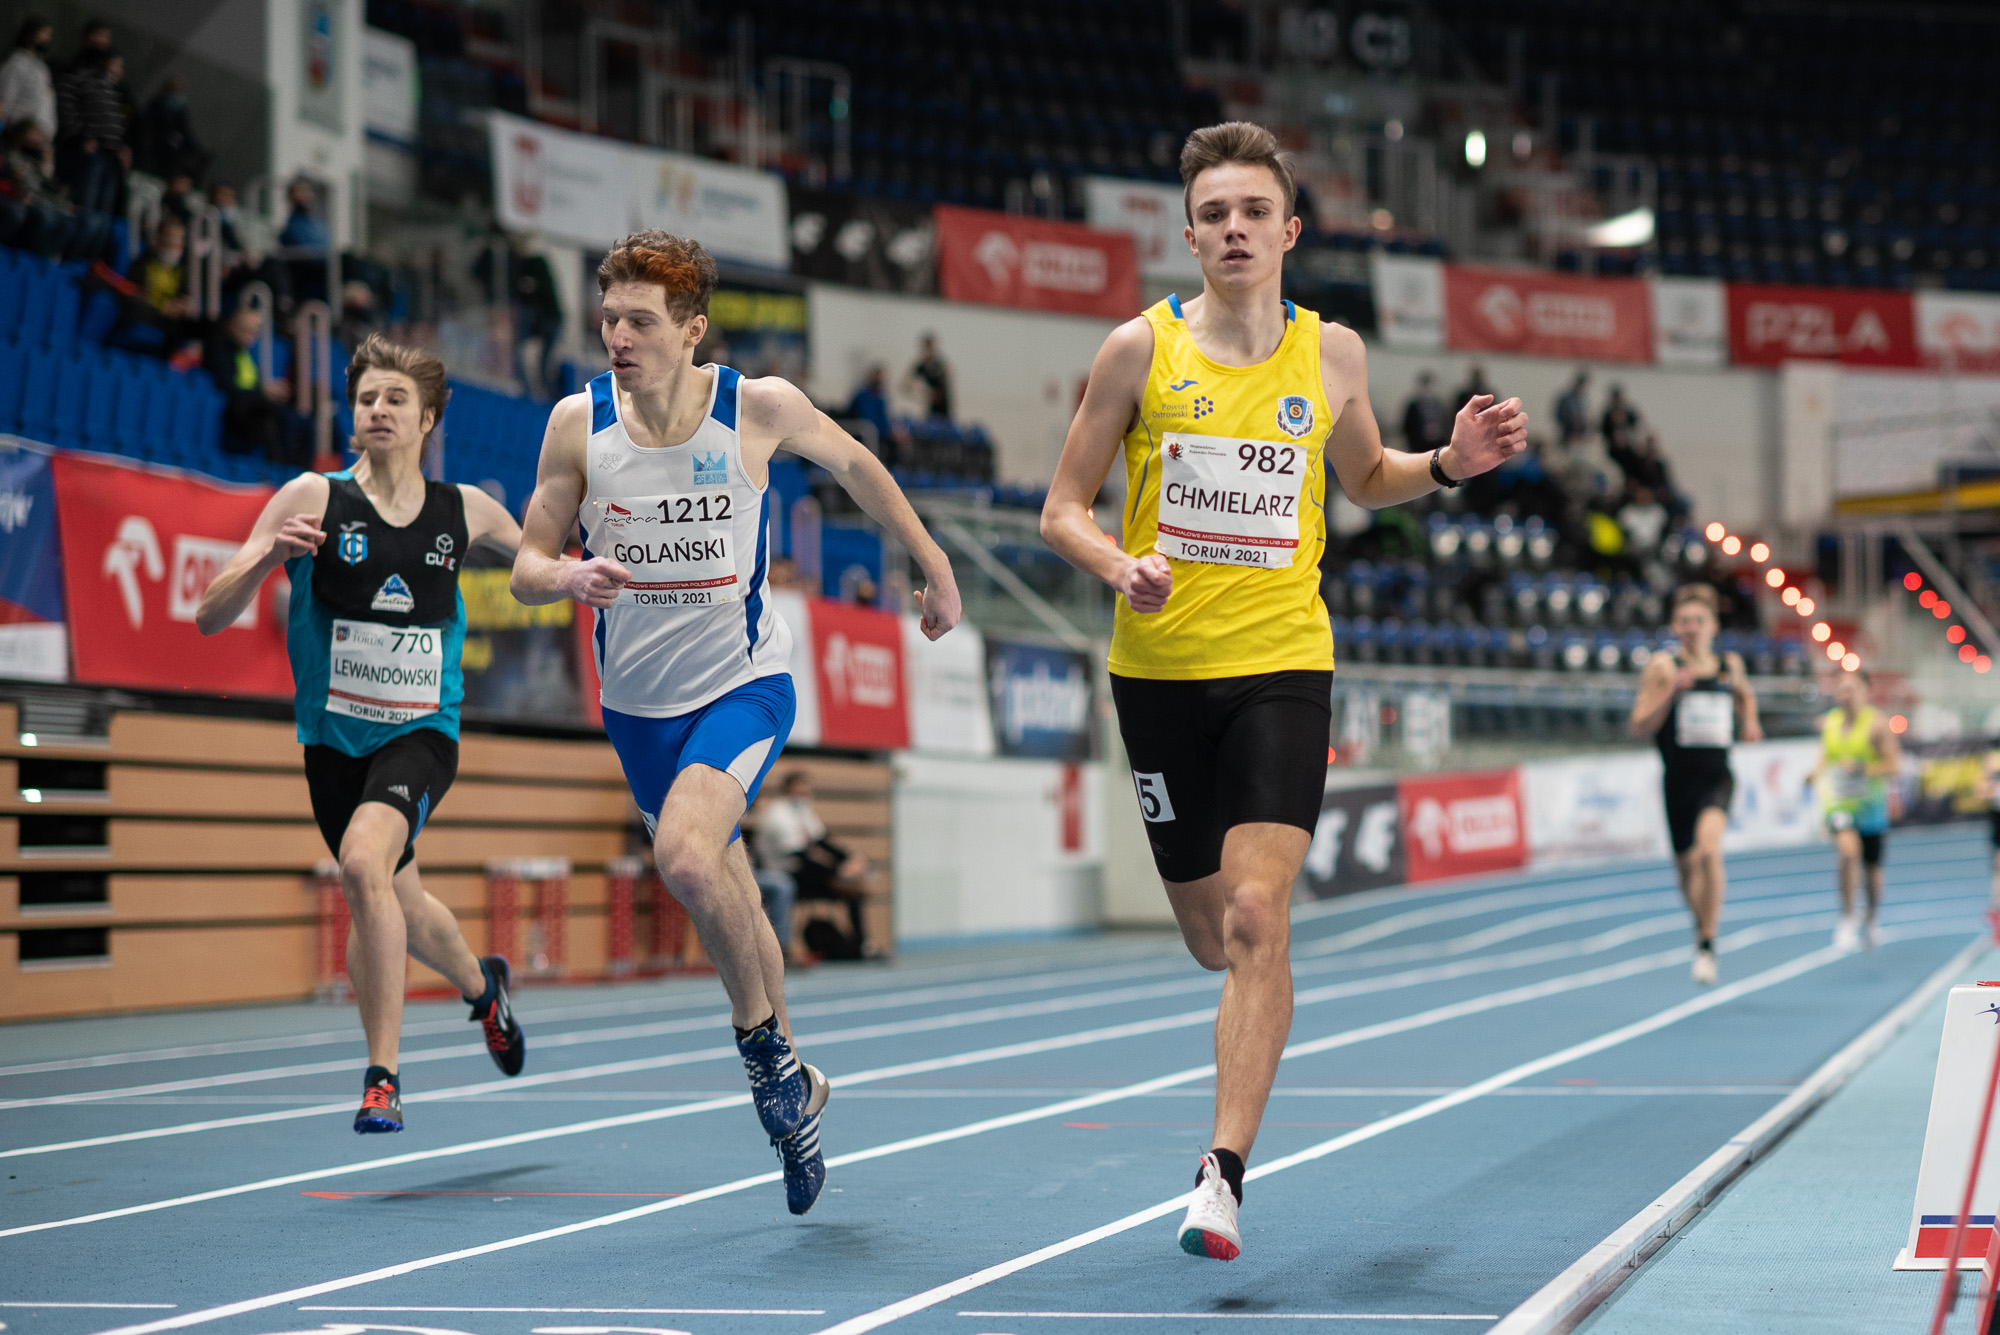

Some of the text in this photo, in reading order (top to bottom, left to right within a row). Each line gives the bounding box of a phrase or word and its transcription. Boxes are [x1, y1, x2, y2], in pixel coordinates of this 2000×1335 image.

[1152, 411, 1188, 419] Ostrowski
[1162, 403, 1188, 411] Powiat
[1238, 443, 1296, 475] 982
[657, 494, 732, 524] 1212
[1166, 482, 1295, 518] CHMIELARZ
[1161, 525, 1175, 533] PZLA
[1175, 530, 1201, 538] HALOWE
[1201, 534, 1247, 543] MISTRZOSTWA
[614, 537, 725, 564] GOLAŃSKI
[1181, 543, 1267, 563] TORUŃ 2021
[633, 590, 711, 605] TORUŃ 2021
[391, 632, 433, 654] 770
[335, 657, 437, 687] LEWANDOWSKI
[349, 703, 414, 721] TORUŃ 2021
[1138, 777, 1161, 819] 5
